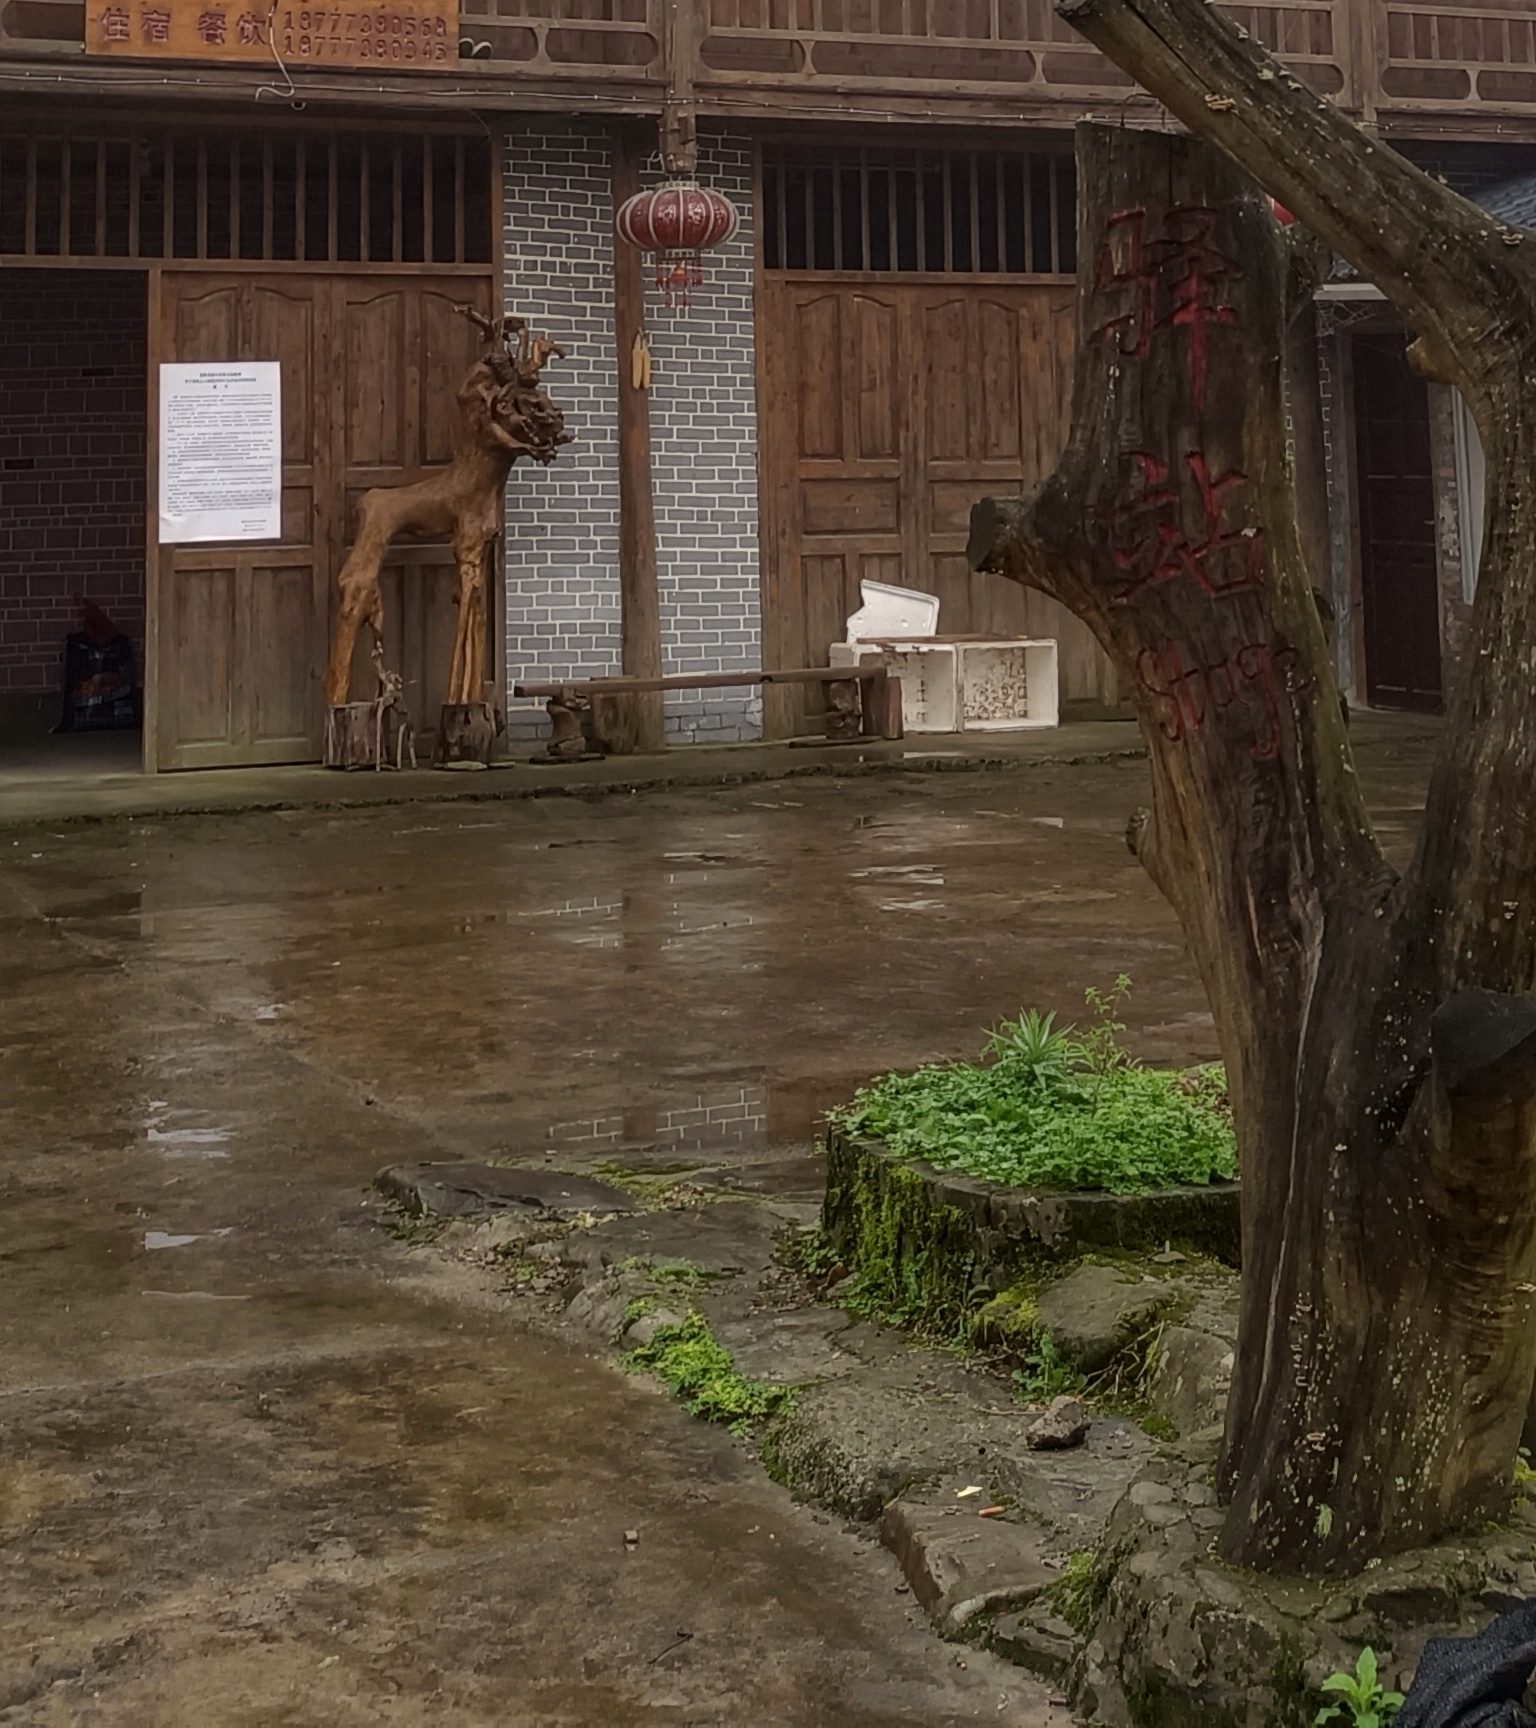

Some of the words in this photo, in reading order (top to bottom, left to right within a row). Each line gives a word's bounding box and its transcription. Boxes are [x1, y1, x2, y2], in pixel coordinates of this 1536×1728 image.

[99, 6, 171, 43] 住宿
[197, 10, 267, 46] 餐饮
[283, 34, 448, 62] 18777380345
[1087, 205, 1264, 605] 驿站
